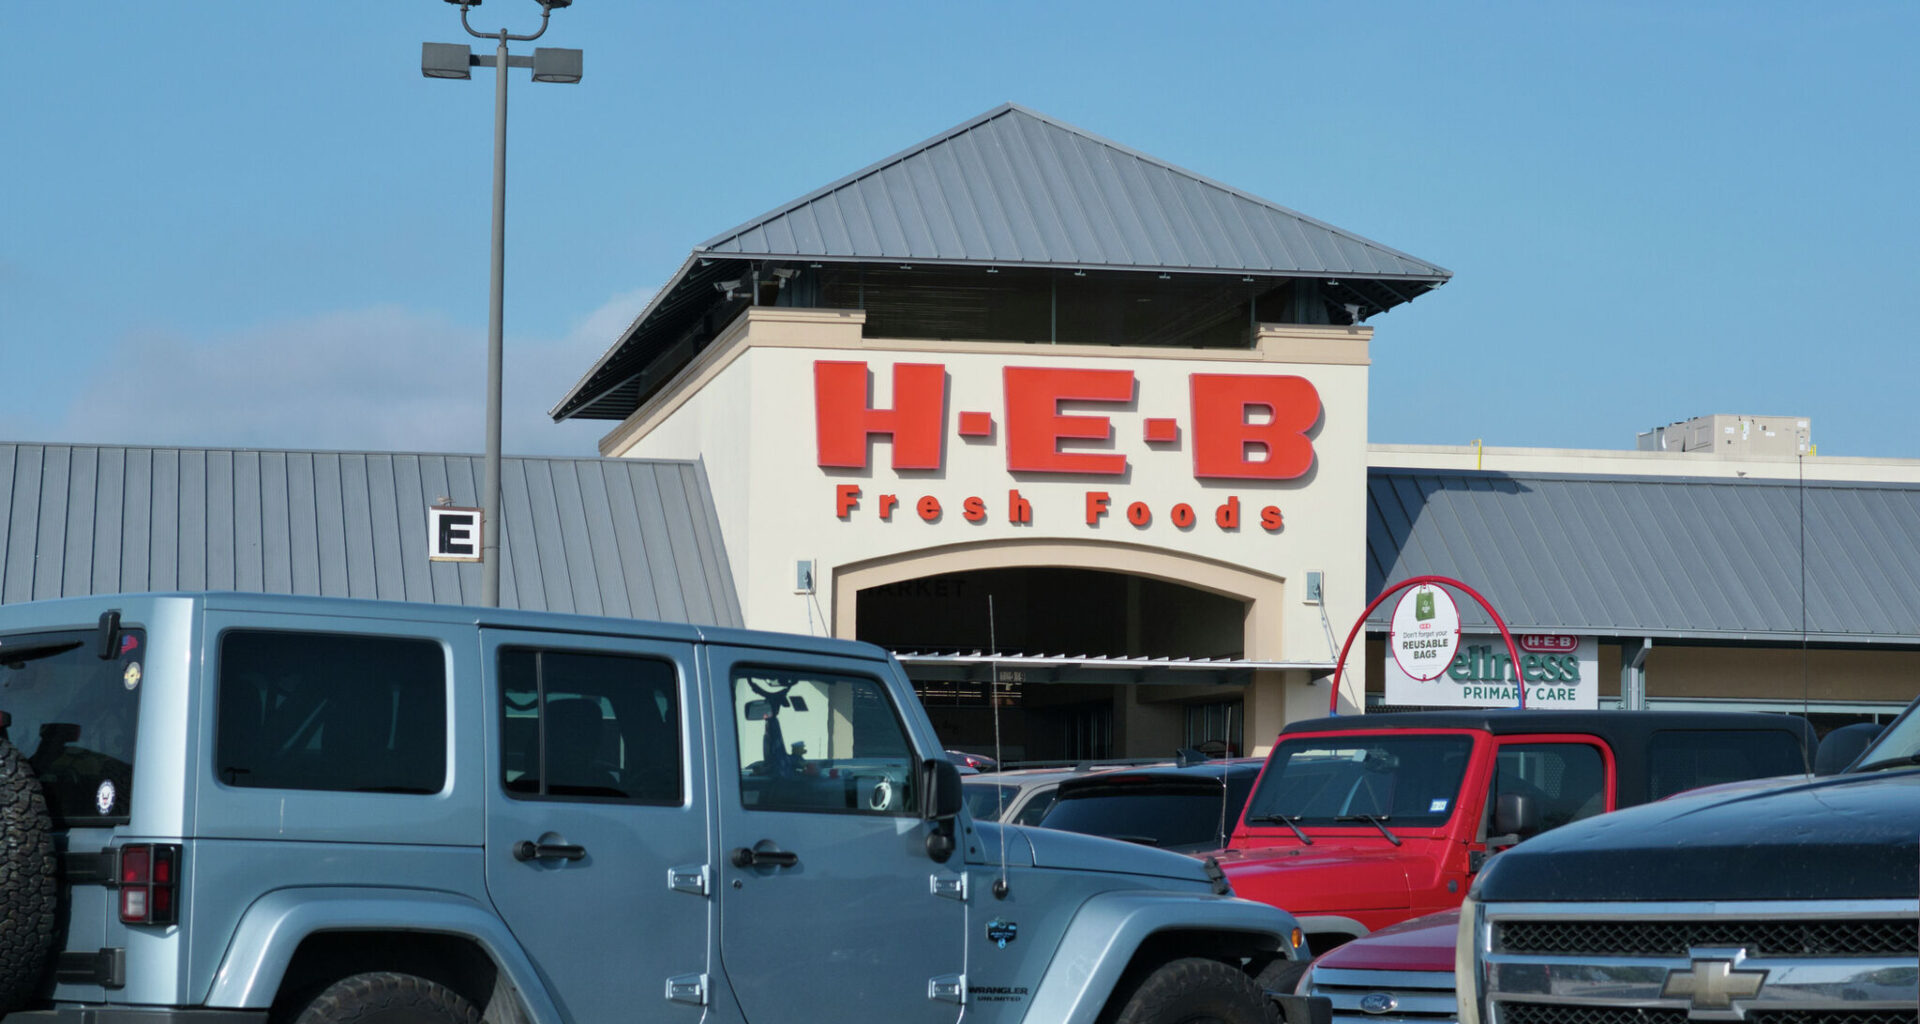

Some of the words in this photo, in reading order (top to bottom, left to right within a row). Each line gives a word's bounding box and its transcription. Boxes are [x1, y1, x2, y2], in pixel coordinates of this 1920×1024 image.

[836, 484, 1032, 523] Fresh
[1086, 491, 1284, 531] Foods
[438, 514, 474, 555] E
[866, 579, 967, 598] ARKET
[1418, 631, 1435, 639] forget
[1435, 630, 1448, 638] your
[1402, 639, 1449, 650] REUSABLE
[1413, 650, 1437, 660] BAGS
[1449, 644, 1580, 683] ellness
[1463, 686, 1531, 700] PRIMARY
[1536, 688, 1576, 701] CARE
[968, 986, 1029, 995] WRANGLER
